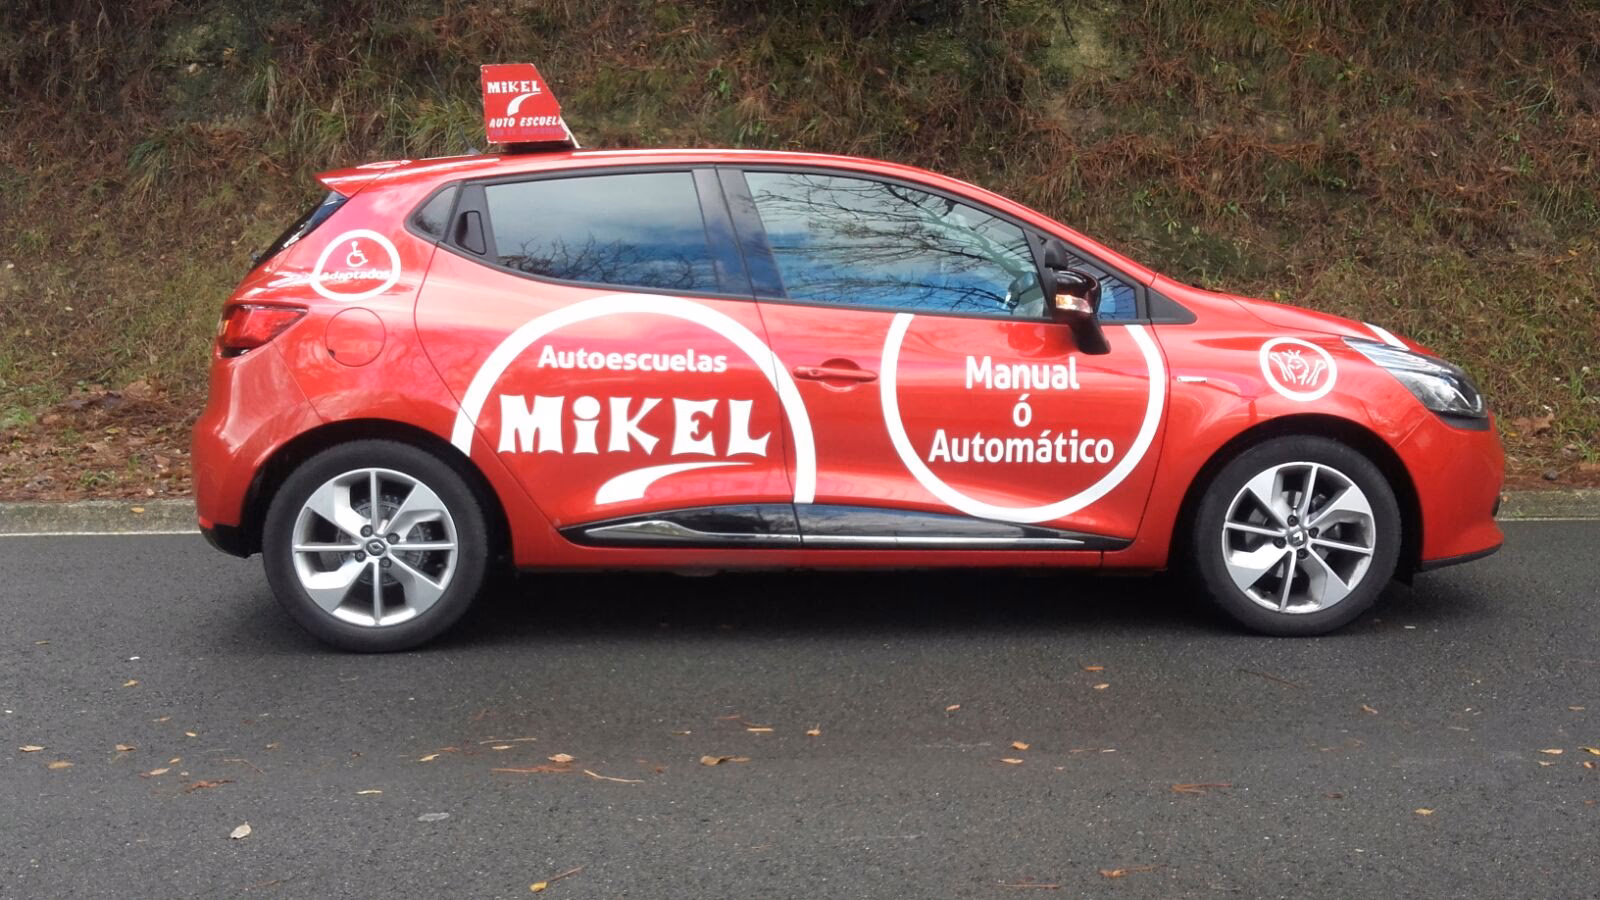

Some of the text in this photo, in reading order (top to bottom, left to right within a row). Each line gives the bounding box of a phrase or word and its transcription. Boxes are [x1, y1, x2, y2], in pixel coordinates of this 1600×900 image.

[489, 117, 516, 128] AUTO
[537, 345, 727, 373] Autoescuelas
[965, 355, 1080, 390] Manual
[1012, 393, 1032, 427] ó
[928, 429, 1114, 463] Automático
